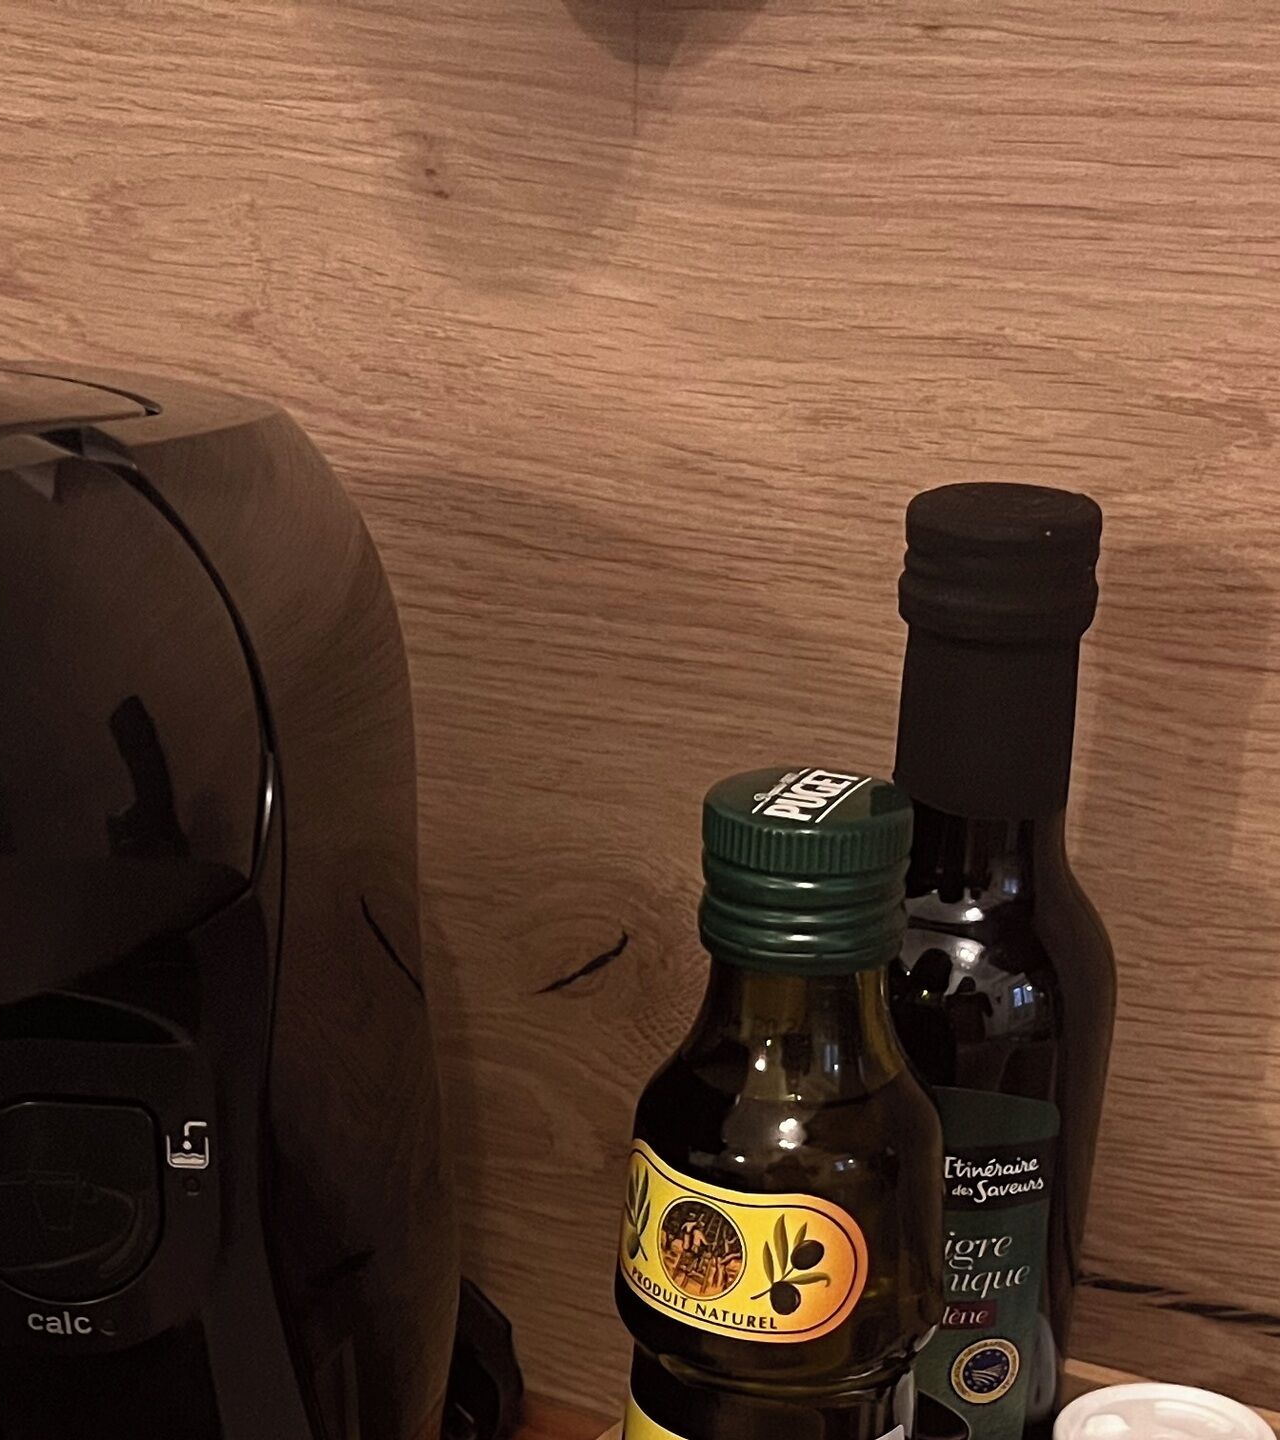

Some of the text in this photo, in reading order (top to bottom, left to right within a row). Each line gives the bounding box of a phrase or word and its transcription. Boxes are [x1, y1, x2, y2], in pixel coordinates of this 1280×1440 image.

[763, 769, 860, 822] PUGET
[951, 1177, 1044, 1204] des Saveurs
[631, 1266, 778, 1331] PRODUIT NATUREL
[27, 1311, 93, 1335] calc
